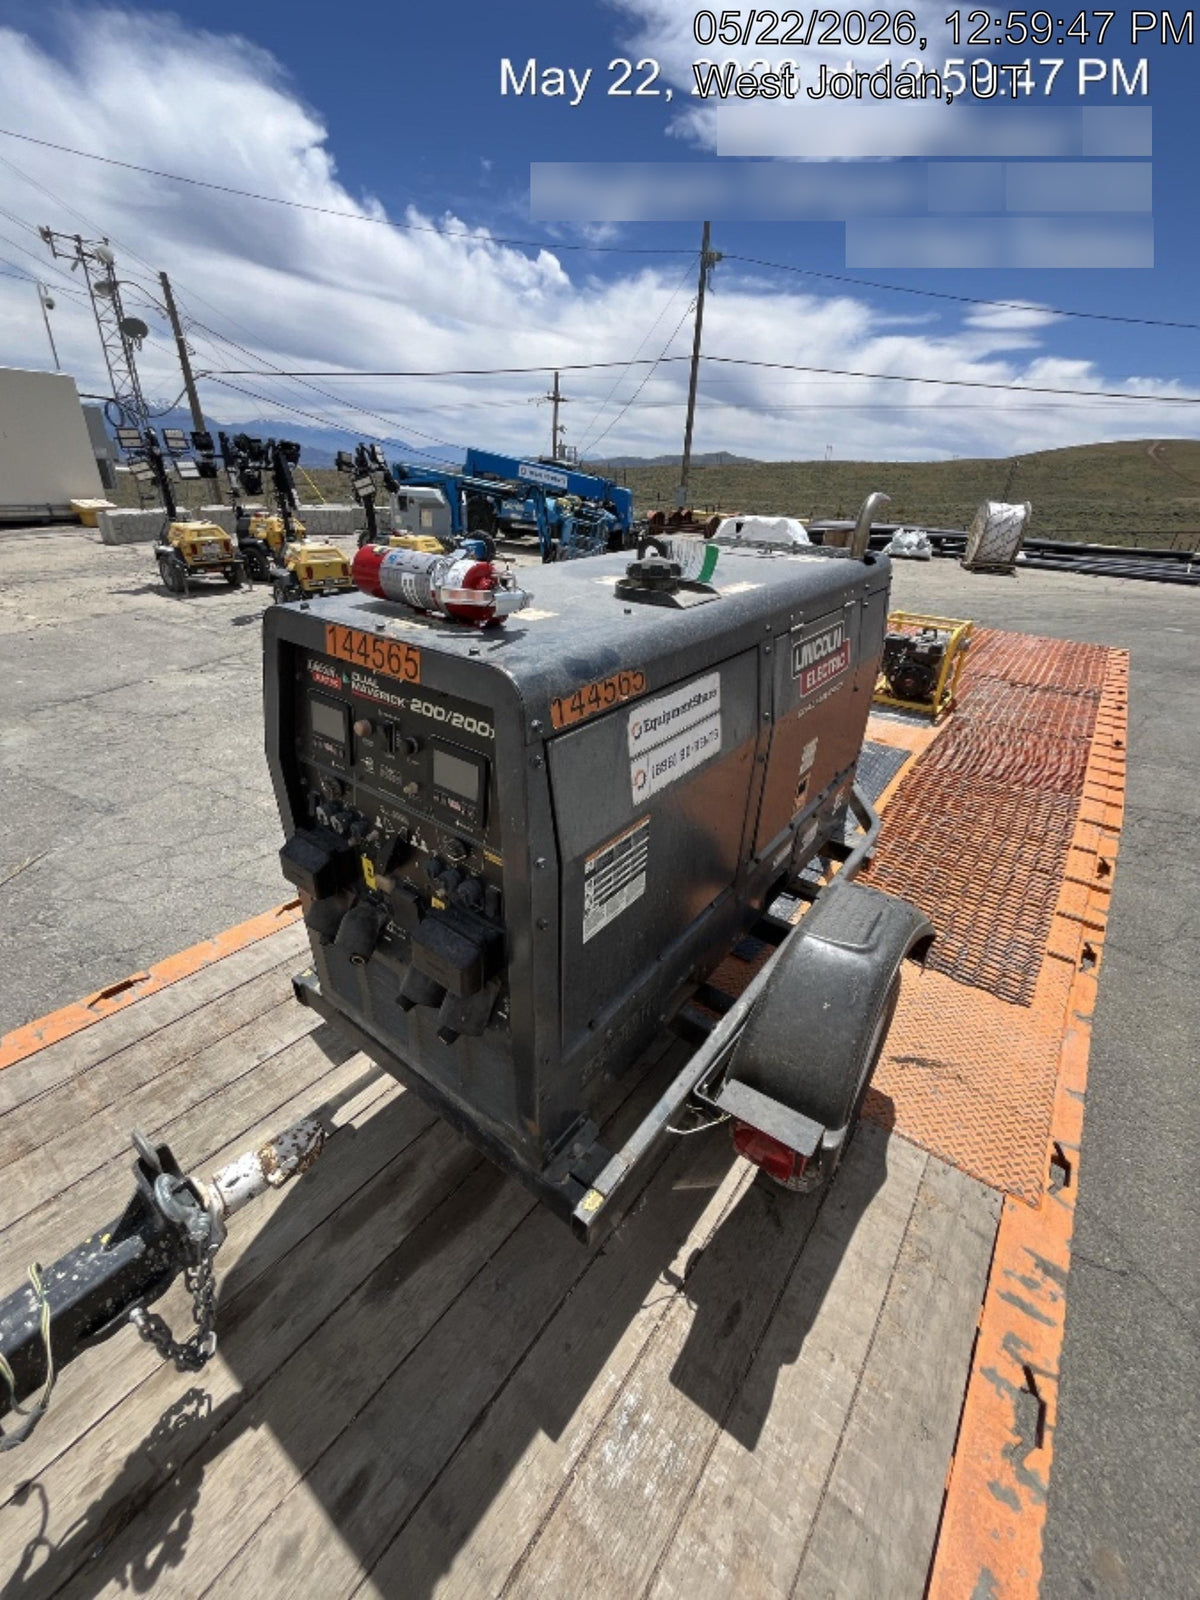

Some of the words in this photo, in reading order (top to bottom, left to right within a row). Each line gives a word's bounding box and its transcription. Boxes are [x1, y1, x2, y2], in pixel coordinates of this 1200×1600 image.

[327, 626, 420, 681] 144565
[794, 626, 843, 671] LINCOLN
[806, 652, 846, 690] ELECTRIC
[551, 671, 645, 724] 144565
